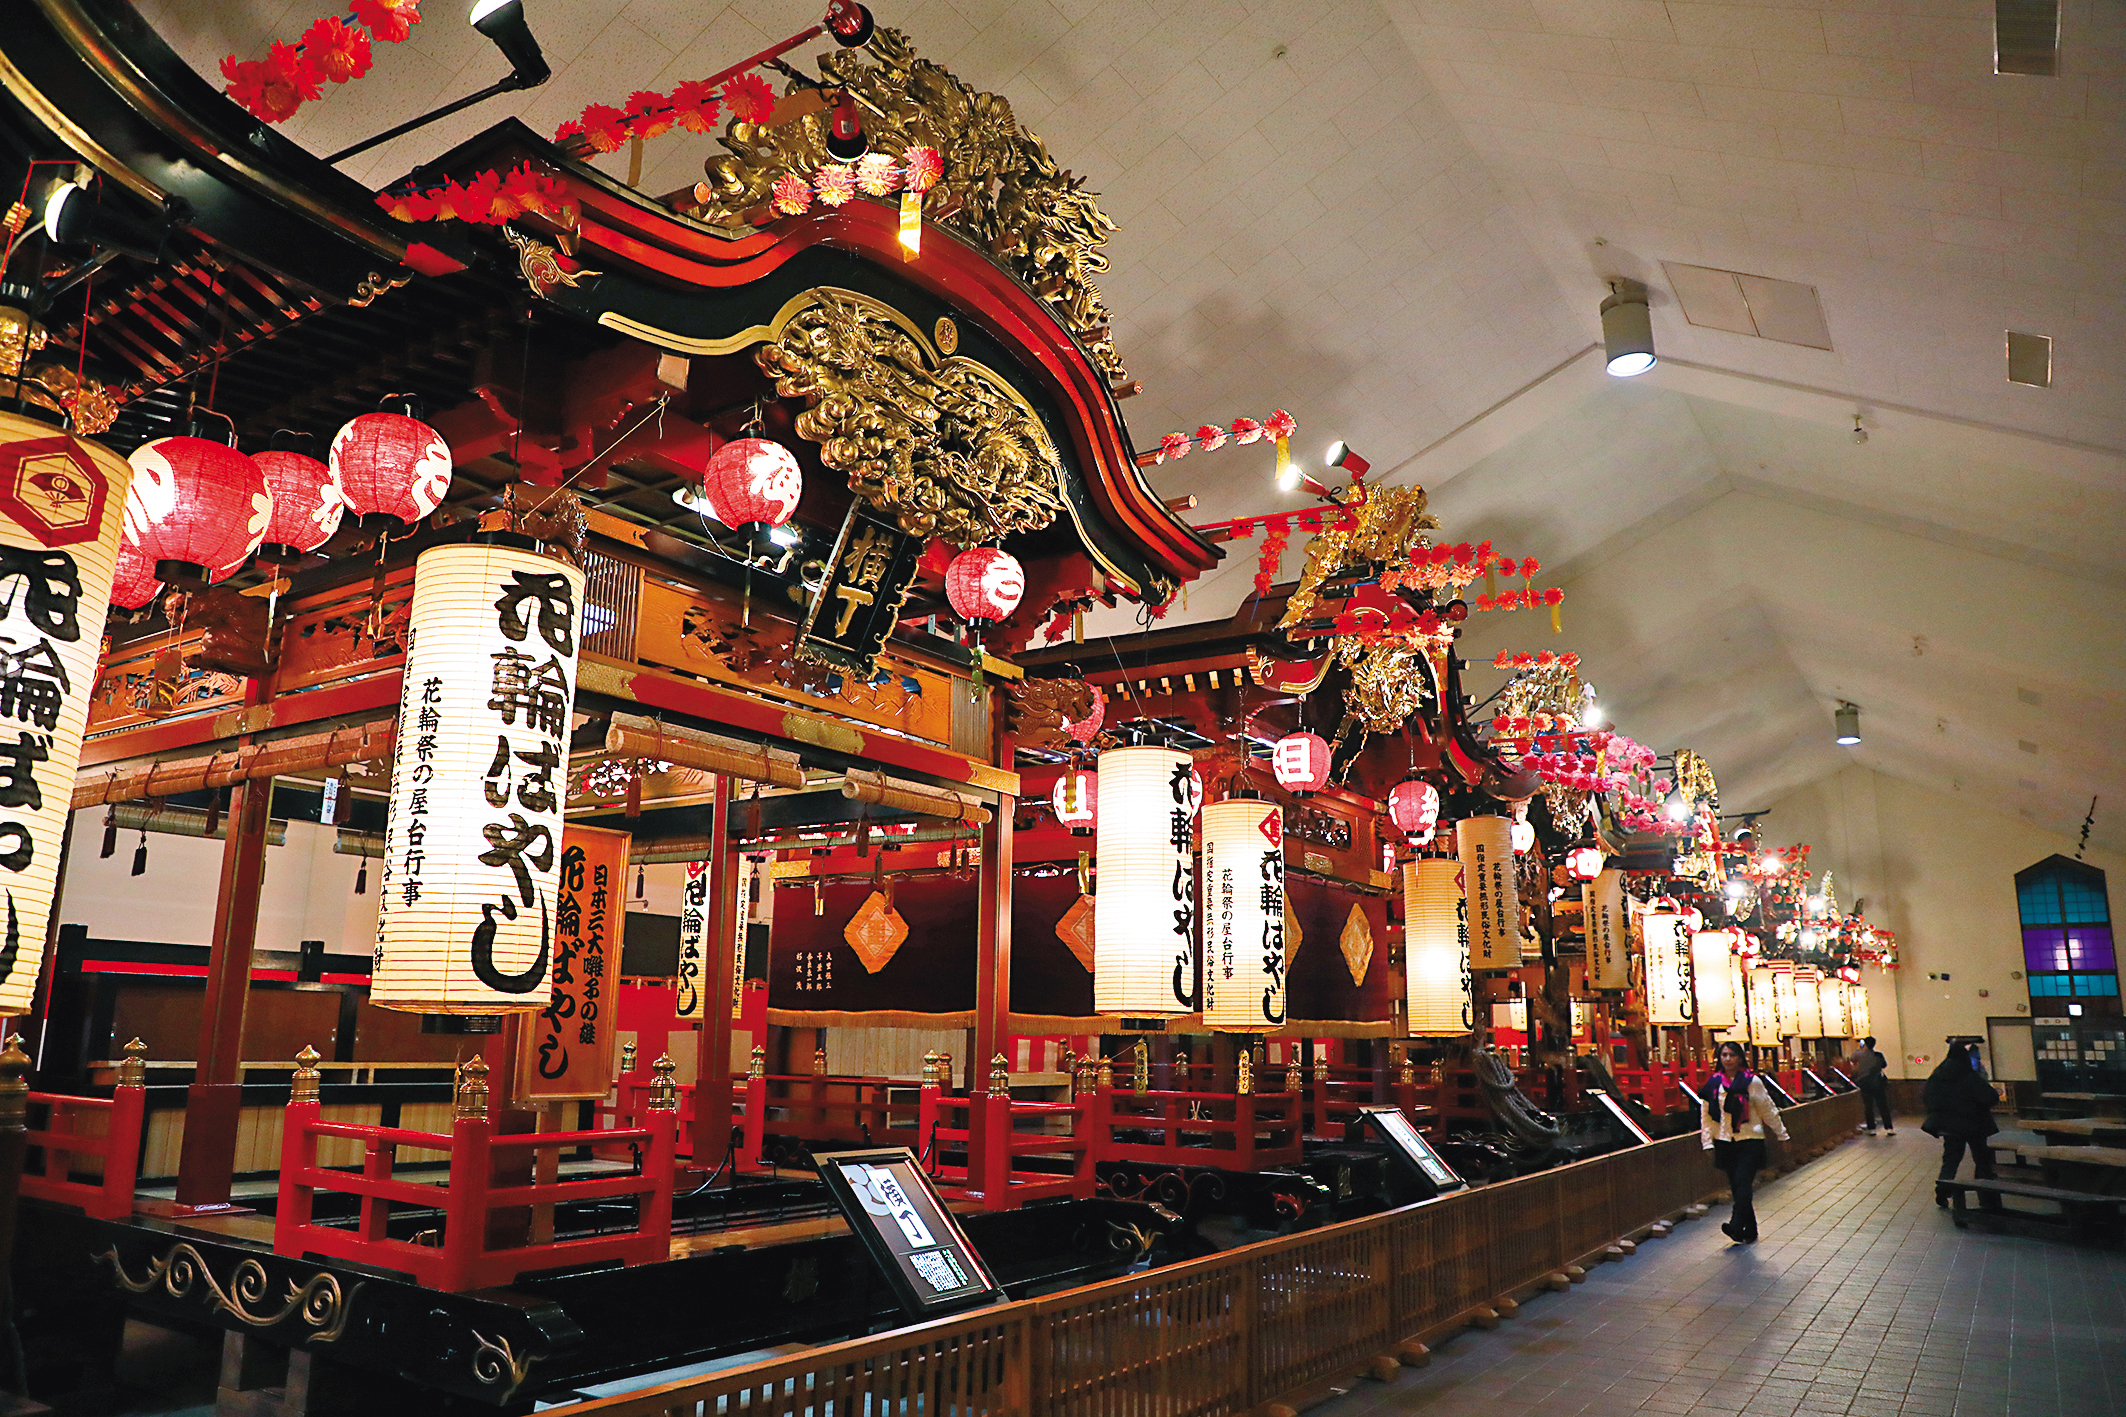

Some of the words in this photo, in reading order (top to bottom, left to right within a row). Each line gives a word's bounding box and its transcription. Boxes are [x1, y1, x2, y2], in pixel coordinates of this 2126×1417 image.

[835, 525, 894, 638] 横丁
[401, 677, 443, 907] 花輪祭の屋台行事
[471, 569, 578, 995] 花輪ばやし
[1221, 868, 1234, 980] 花輪祭の屋台行事
[1493, 862, 1506, 938] 花輪祭の屋台行事
